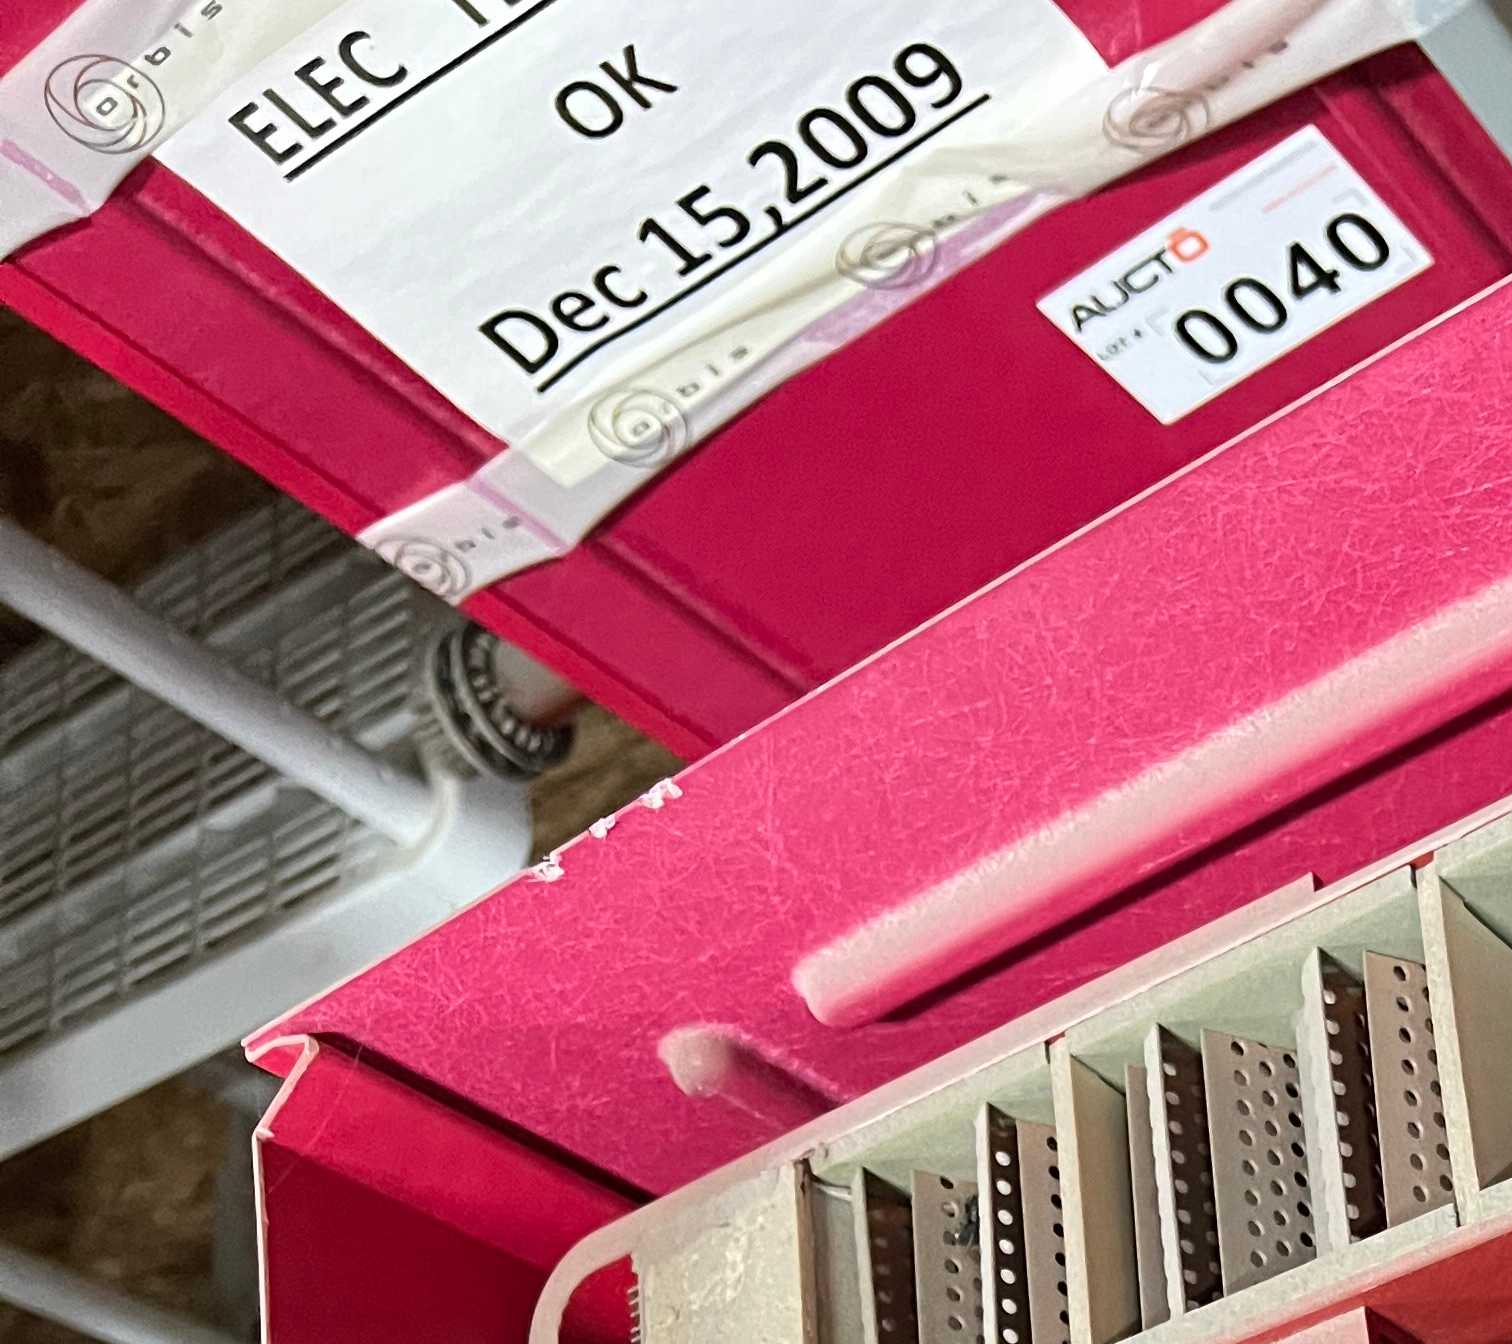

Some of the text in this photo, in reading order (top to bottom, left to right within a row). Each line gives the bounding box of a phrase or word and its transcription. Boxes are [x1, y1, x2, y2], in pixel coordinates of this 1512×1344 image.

[228, 30, 408, 165] ELEC
[555, 44, 678, 139] OK
[478, 42, 964, 375] Dec 15,2009
[1175, 212, 1390, 363] 0040
